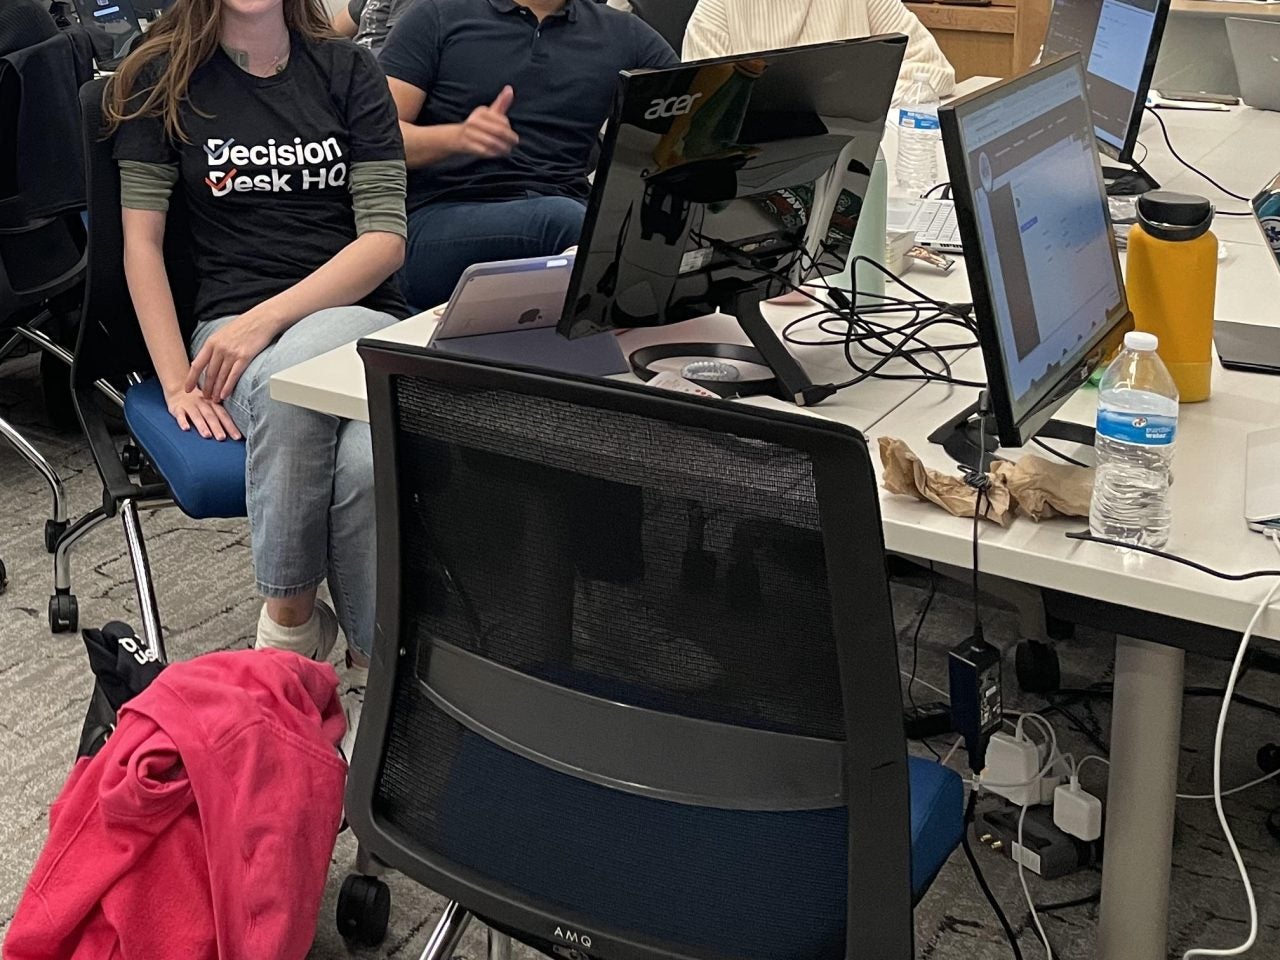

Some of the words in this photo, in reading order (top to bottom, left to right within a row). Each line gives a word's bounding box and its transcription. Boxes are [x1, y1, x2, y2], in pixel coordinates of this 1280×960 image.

[644, 92, 703, 120] acer
[206, 137, 343, 166] Decision
[207, 168, 293, 197] Desk
[302, 162, 347, 190] HQ
[553, 926, 592, 948] AMQ
